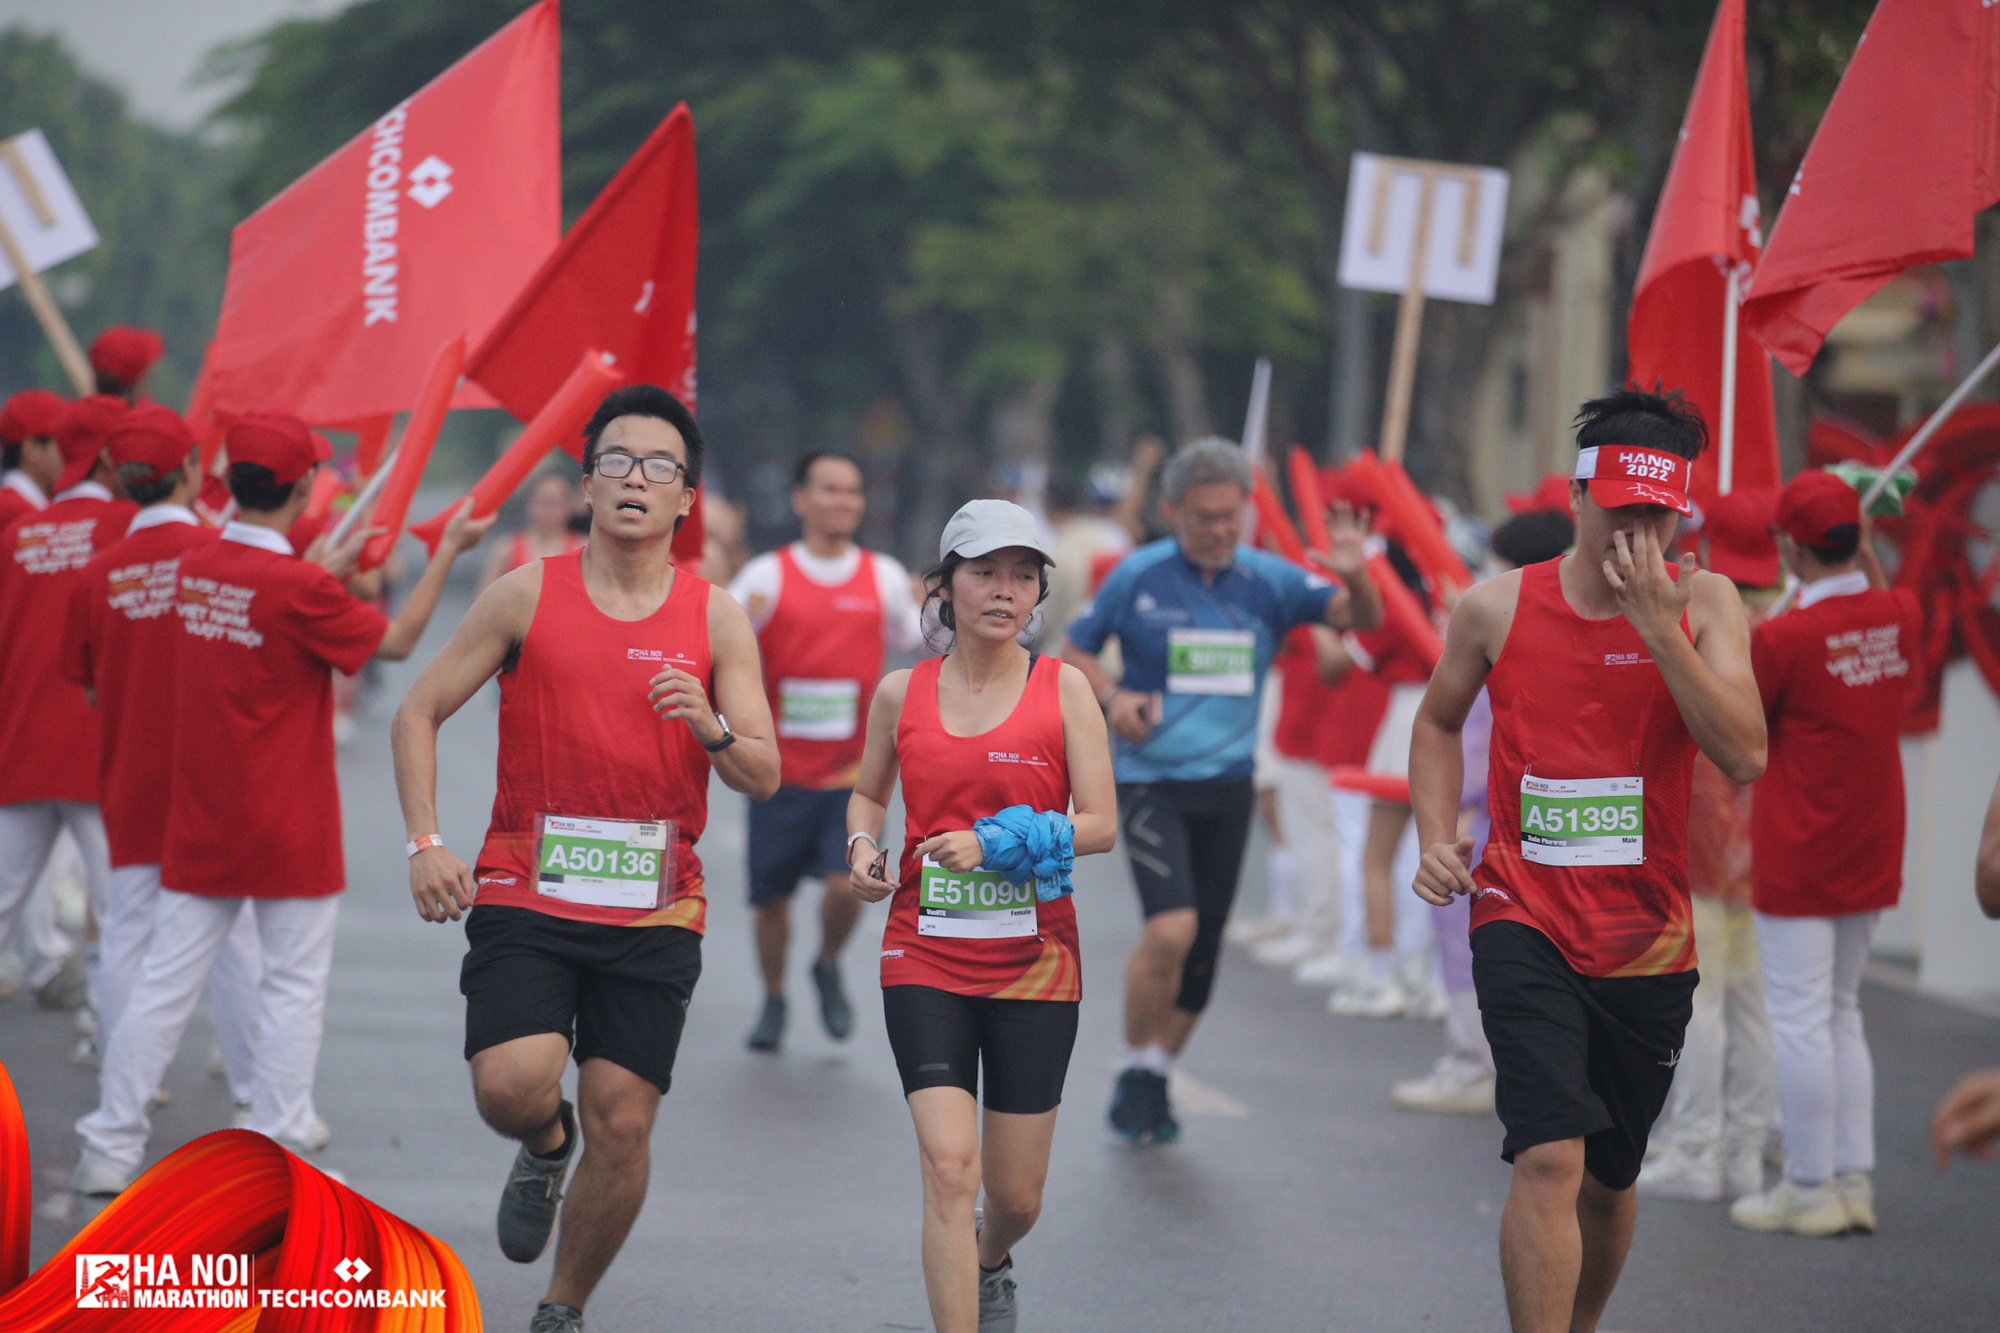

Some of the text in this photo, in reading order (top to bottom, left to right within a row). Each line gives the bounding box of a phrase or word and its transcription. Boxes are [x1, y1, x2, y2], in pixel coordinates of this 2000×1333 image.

[363, 101, 408, 327] CHCOMBANK
[1618, 452, 1676, 473] HANOI
[1626, 463, 1669, 482] 2022
[639, 649, 662, 658] HA NOI
[1615, 652, 1638, 661] HA NOI
[998, 751, 1020, 760] HA NOI
[1525, 804, 1639, 833] A51395
[545, 844, 657, 877] A50136
[1010, 909, 1032, 917] Female
